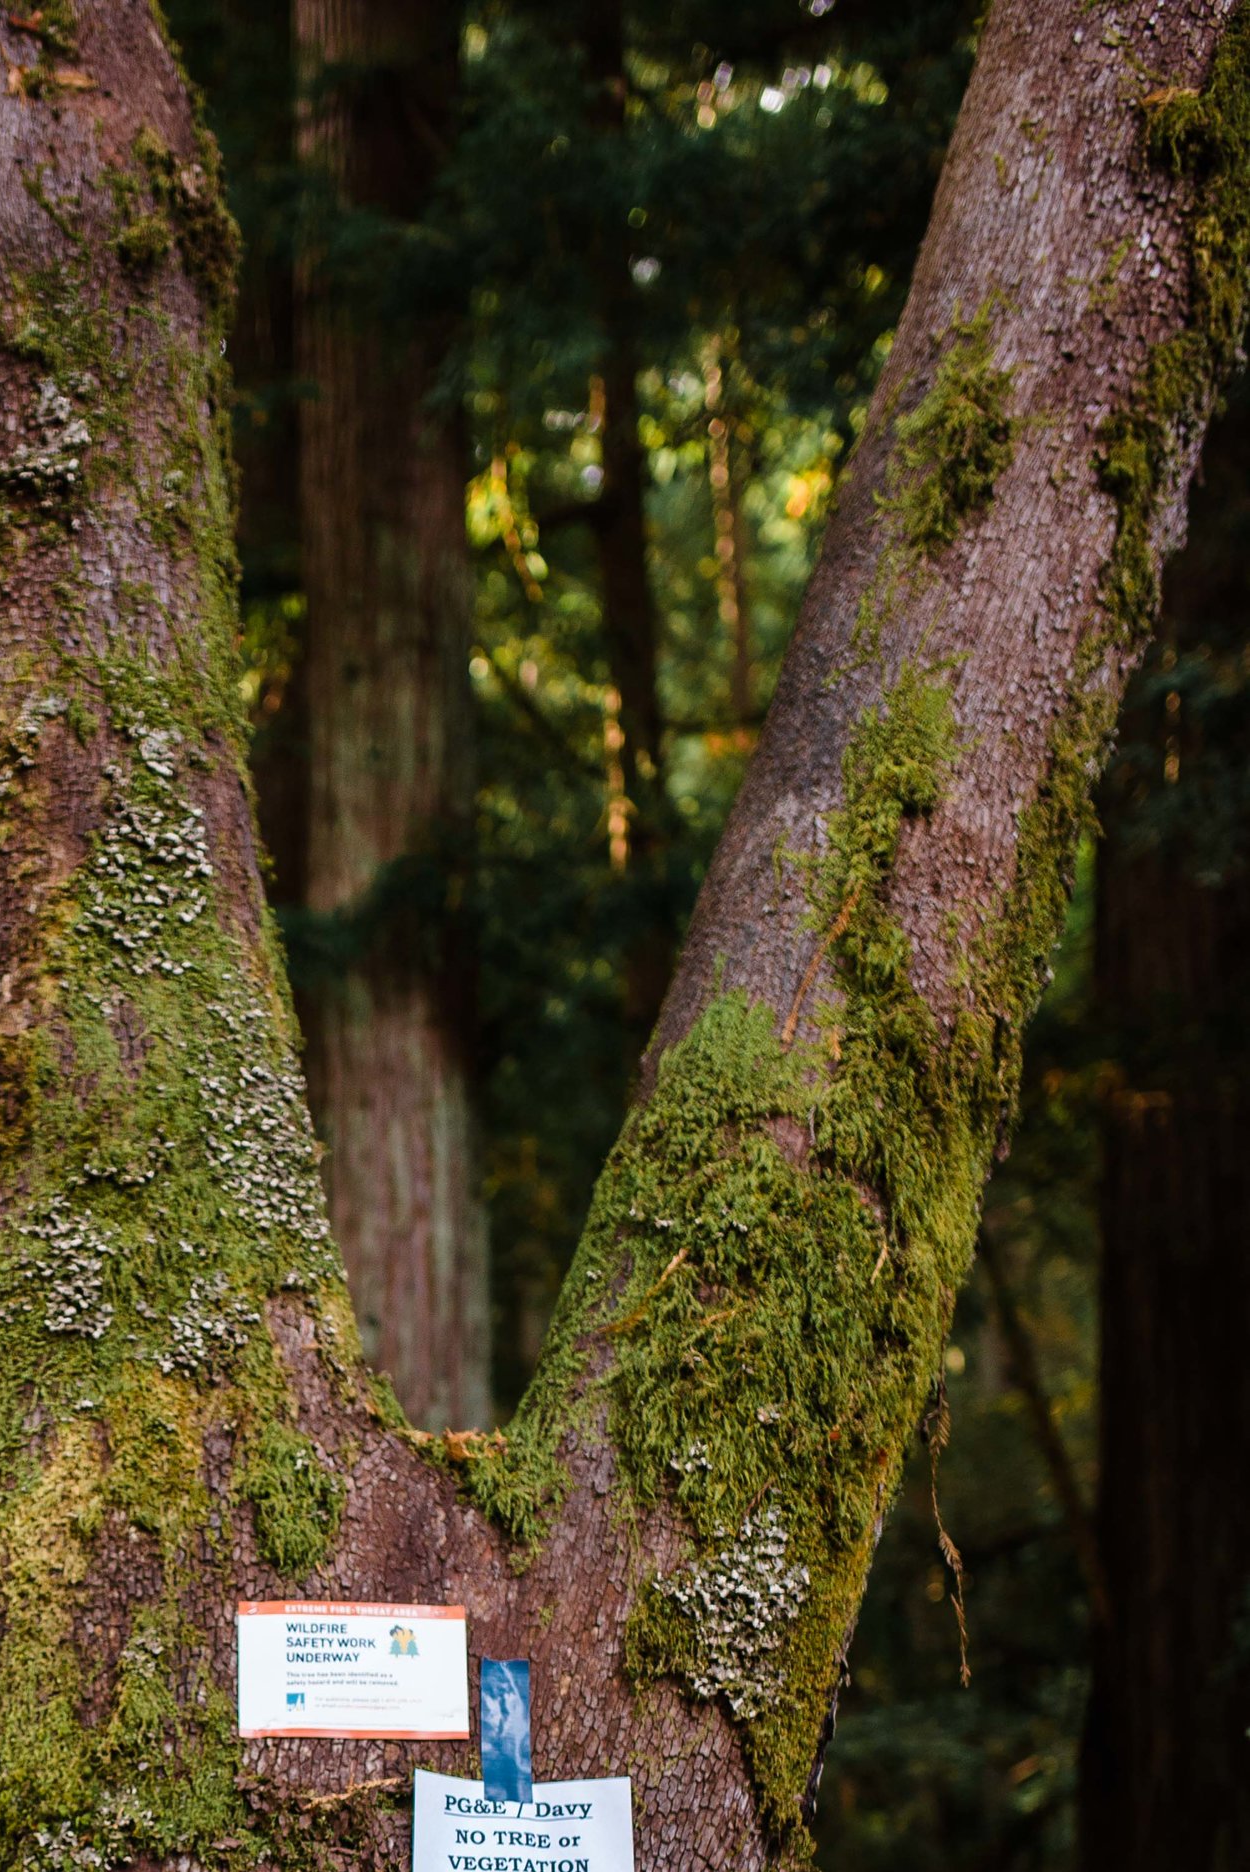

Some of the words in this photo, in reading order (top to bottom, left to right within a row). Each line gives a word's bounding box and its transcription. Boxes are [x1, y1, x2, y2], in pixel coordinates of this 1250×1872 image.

[285, 1604, 327, 1613] EXTREME
[393, 1608, 417, 1616] AREA
[286, 1623, 347, 1633] WILDFIRE
[286, 1638, 334, 1648] SAFETY
[337, 1638, 376, 1648] WORK
[286, 1653, 360, 1662] UNDERWAY
[445, 1794, 506, 1814] PG&E
[535, 1802, 592, 1819] Davy
[455, 1829, 485, 1845] NO
[493, 1831, 550, 1848] TREE
[559, 1834, 580, 1847] or
